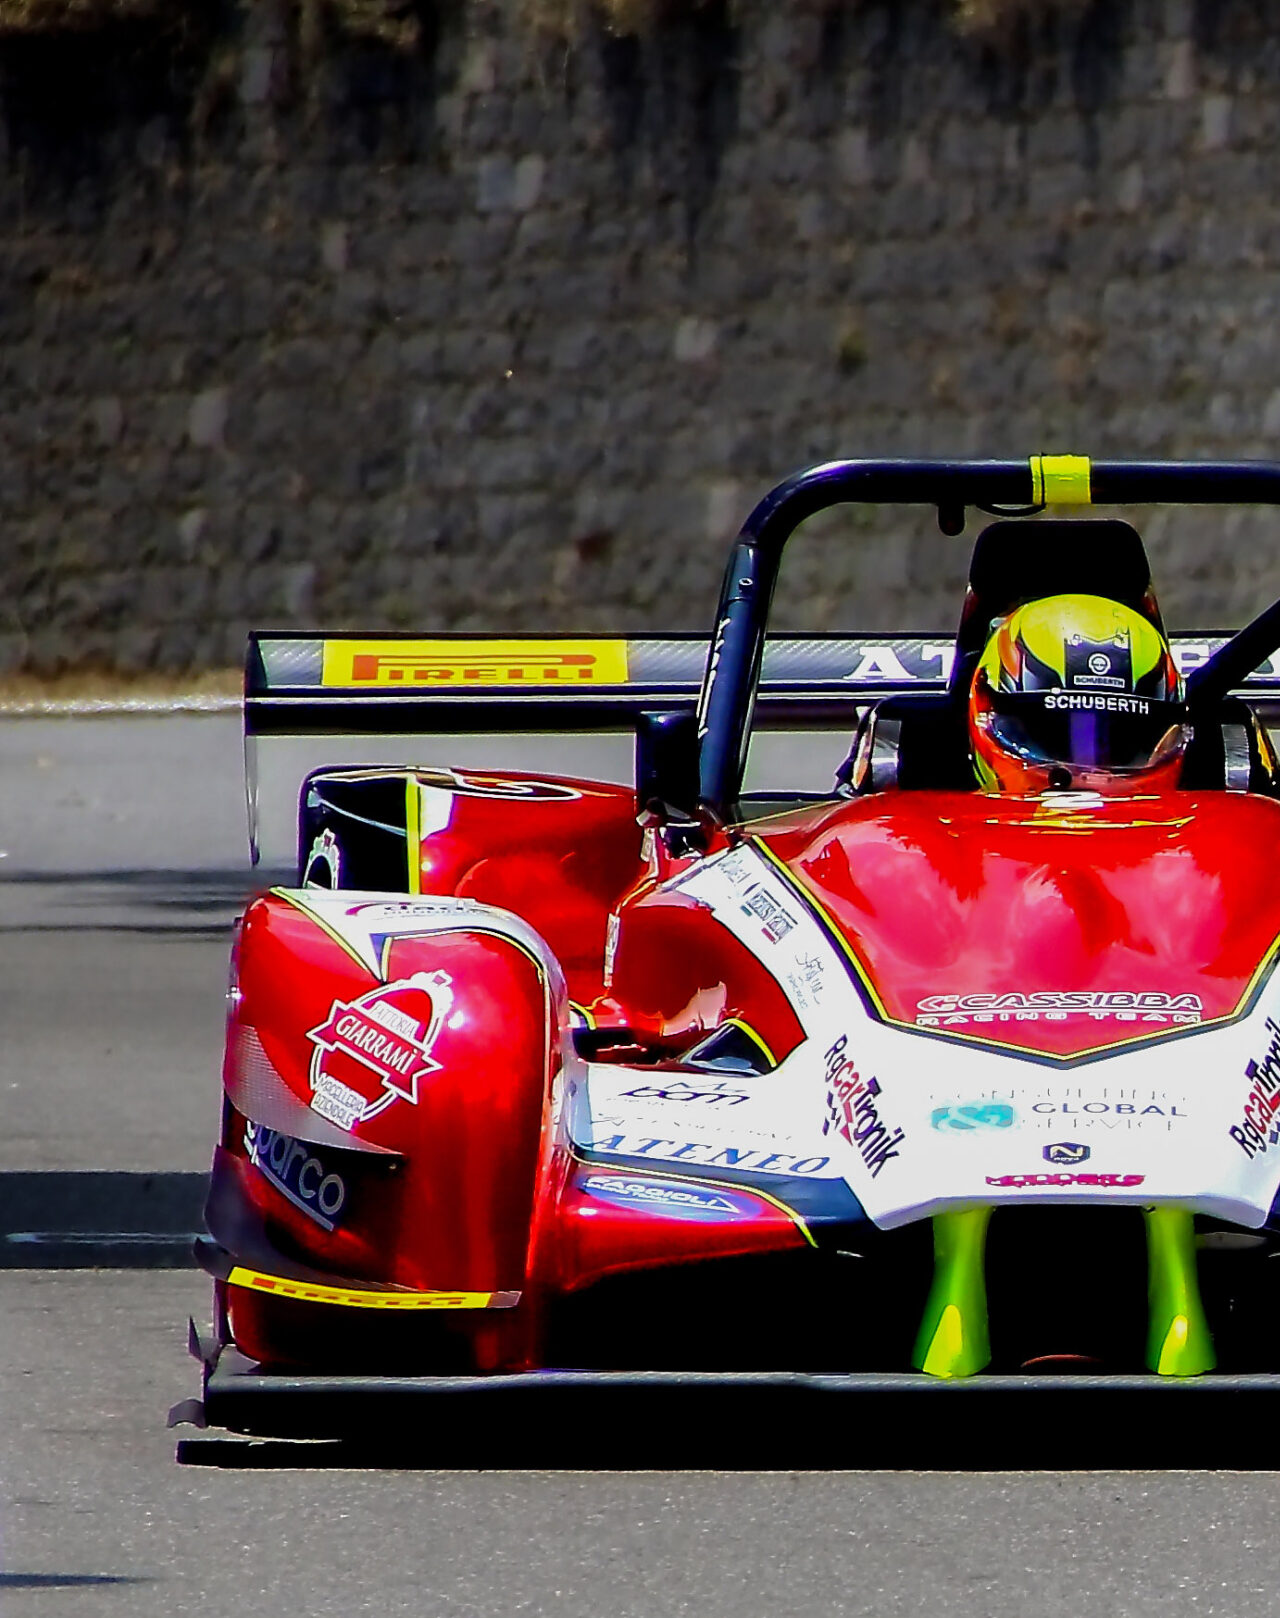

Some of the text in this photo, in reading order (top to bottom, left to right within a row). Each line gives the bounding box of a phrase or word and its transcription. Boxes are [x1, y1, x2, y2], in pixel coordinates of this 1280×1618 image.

[352, 653, 598, 681] PIRELLI
[1074, 676, 1125, 687] SCHUBERTH
[1044, 694, 1149, 715] SCHUBERTH
[1032, 1102, 1188, 1117] GLOBAL
[583, 1133, 831, 1174] ATENEO
